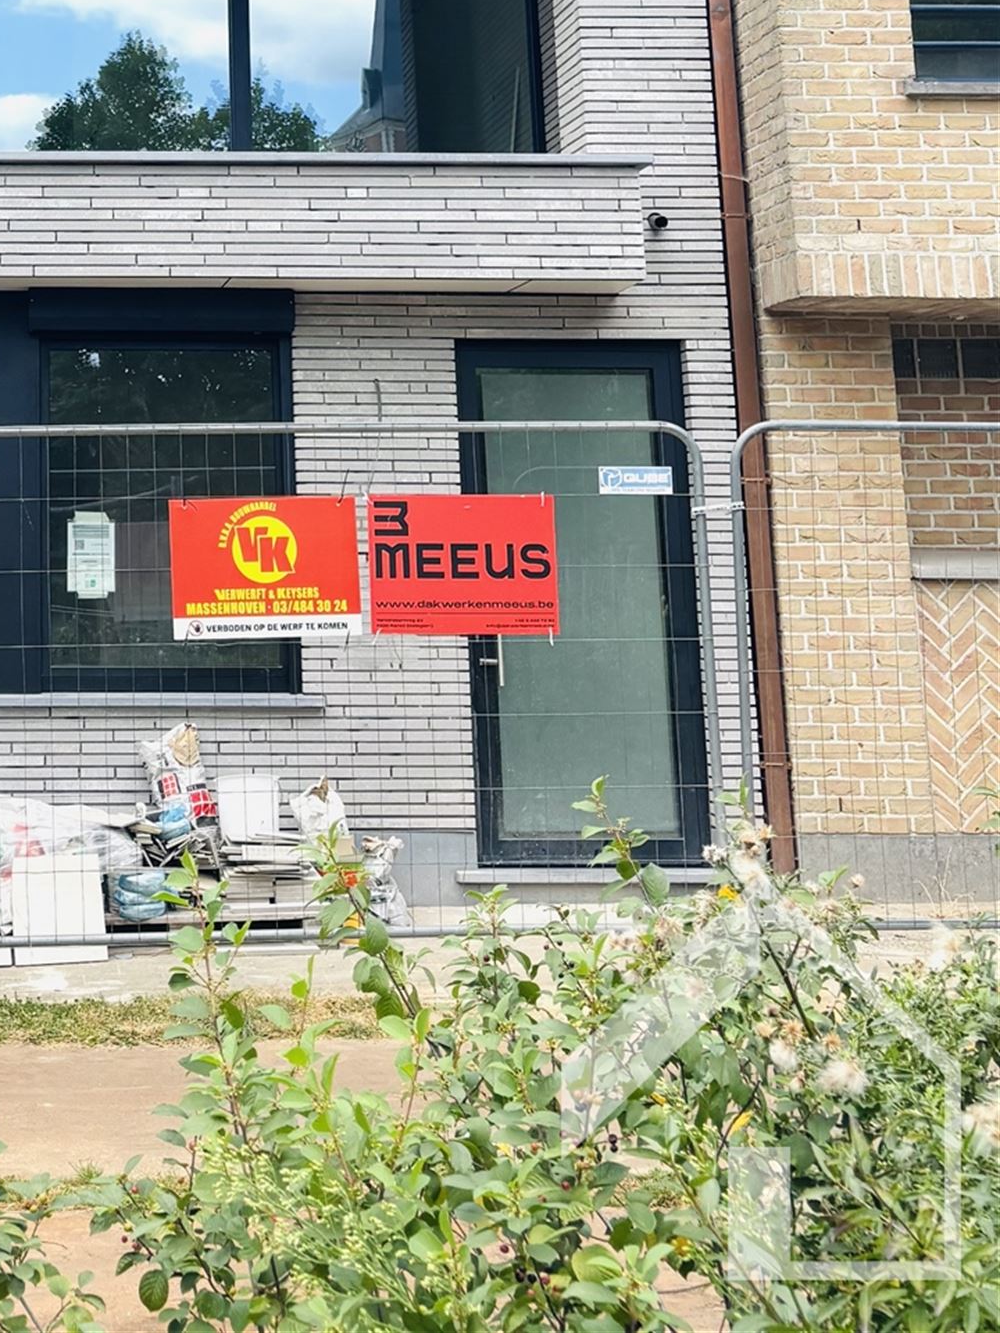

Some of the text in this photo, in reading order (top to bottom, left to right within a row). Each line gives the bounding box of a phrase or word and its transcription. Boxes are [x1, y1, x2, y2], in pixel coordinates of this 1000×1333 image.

[234, 525, 296, 574] VK
[374, 543, 552, 580] MEEUS
[214, 587, 266, 601] VERWERFT
[277, 586, 320, 599] KEYSERS
[186, 599, 348, 616] MASSENHOVEN 03/484 30 24
[376, 600, 554, 609] www.dakwerkenmeeus.be
[206, 621, 348, 633] VERBODEN OP DE WERF TE KOMEN
